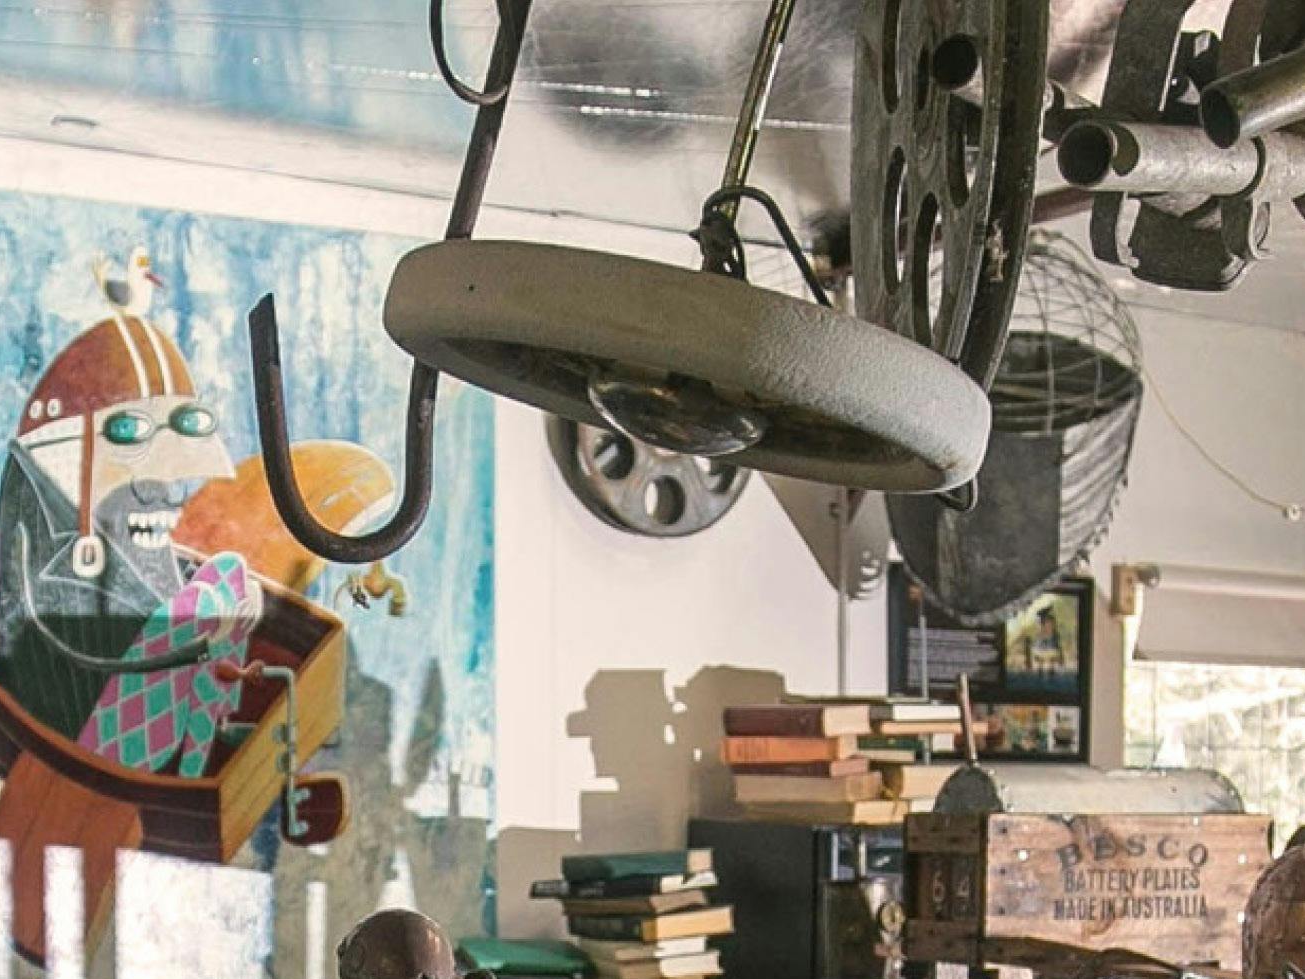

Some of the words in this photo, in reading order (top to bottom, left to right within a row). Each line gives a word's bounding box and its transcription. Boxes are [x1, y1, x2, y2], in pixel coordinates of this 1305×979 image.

[1057, 832, 1208, 868] BESCO
[1065, 868, 1139, 892] BATTERY
[1143, 867, 1200, 890] PLATES
[1054, 897, 1095, 920] MADE
[1102, 897, 1116, 920] IN
[1123, 895, 1207, 919] AUSTRALIA
